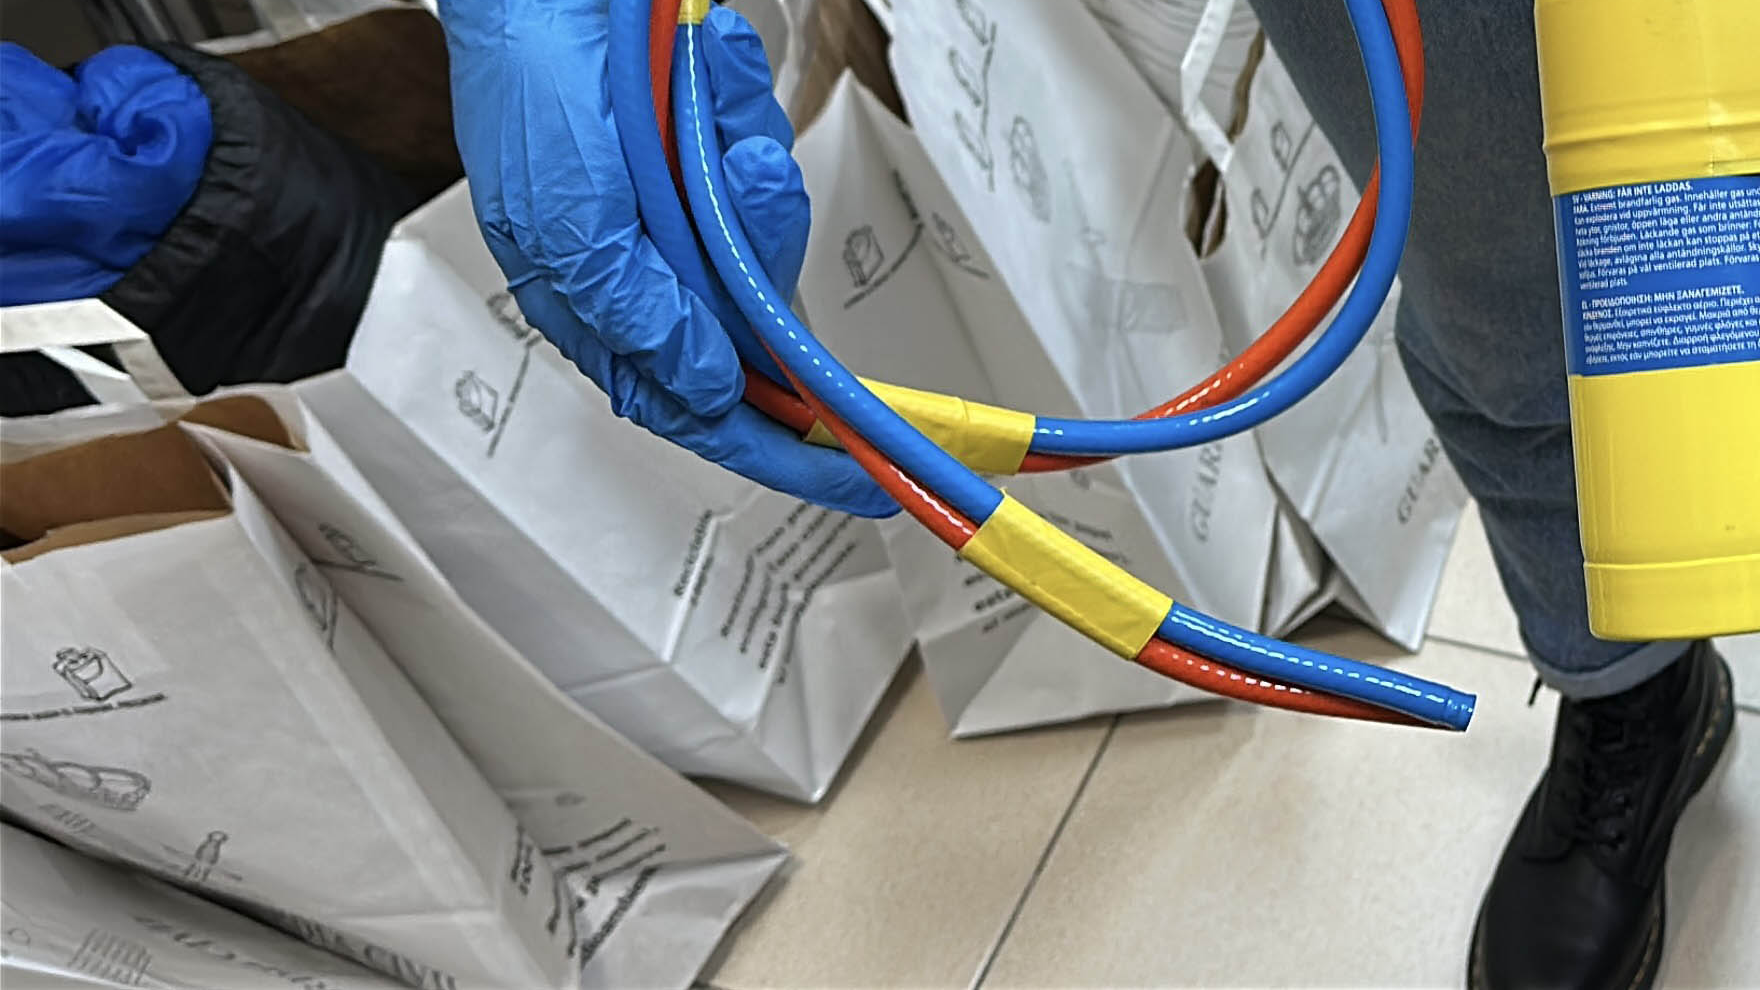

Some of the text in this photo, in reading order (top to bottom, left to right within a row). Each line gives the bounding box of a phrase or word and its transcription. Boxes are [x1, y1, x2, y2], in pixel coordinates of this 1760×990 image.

[1617, 181, 1694, 197] FÅR INTE LADDAS.
[1618, 196, 1663, 209] brandfarlig
[1665, 195, 1682, 205] gas.
[1684, 189, 1729, 202] Innehåller
[1730, 189, 1745, 199] gas
[1619, 197, 1760, 220] vid uppvärmning. inte utsättas
[1631, 212, 1728, 230] öppen låga eller andra
[1624, 244, 1637, 252] om
[1638, 241, 1654, 251] inte
[1656, 238, 1684, 249] läckan
[1686, 236, 1702, 246] kan
[1705, 233, 1738, 246] stoppas
[1740, 232, 1750, 242] på
[1640, 227, 1680, 240] Läckande
[1681, 226, 1697, 238] gas
[1699, 224, 1717, 235] som
[1614, 254, 1648, 266] avlägsna
[1650, 250, 1665, 260] alla
[1666, 243, 1747, 259] antändningskällor.
[1598, 267, 1627, 278] Förvaras
[1628, 266, 1638, 276] på
[1639, 263, 1652, 273] väl
[1653, 259, 1697, 272] ventilerad
[1699, 257, 1721, 269] plats.
[1724, 253, 1760, 265] Förvaras
